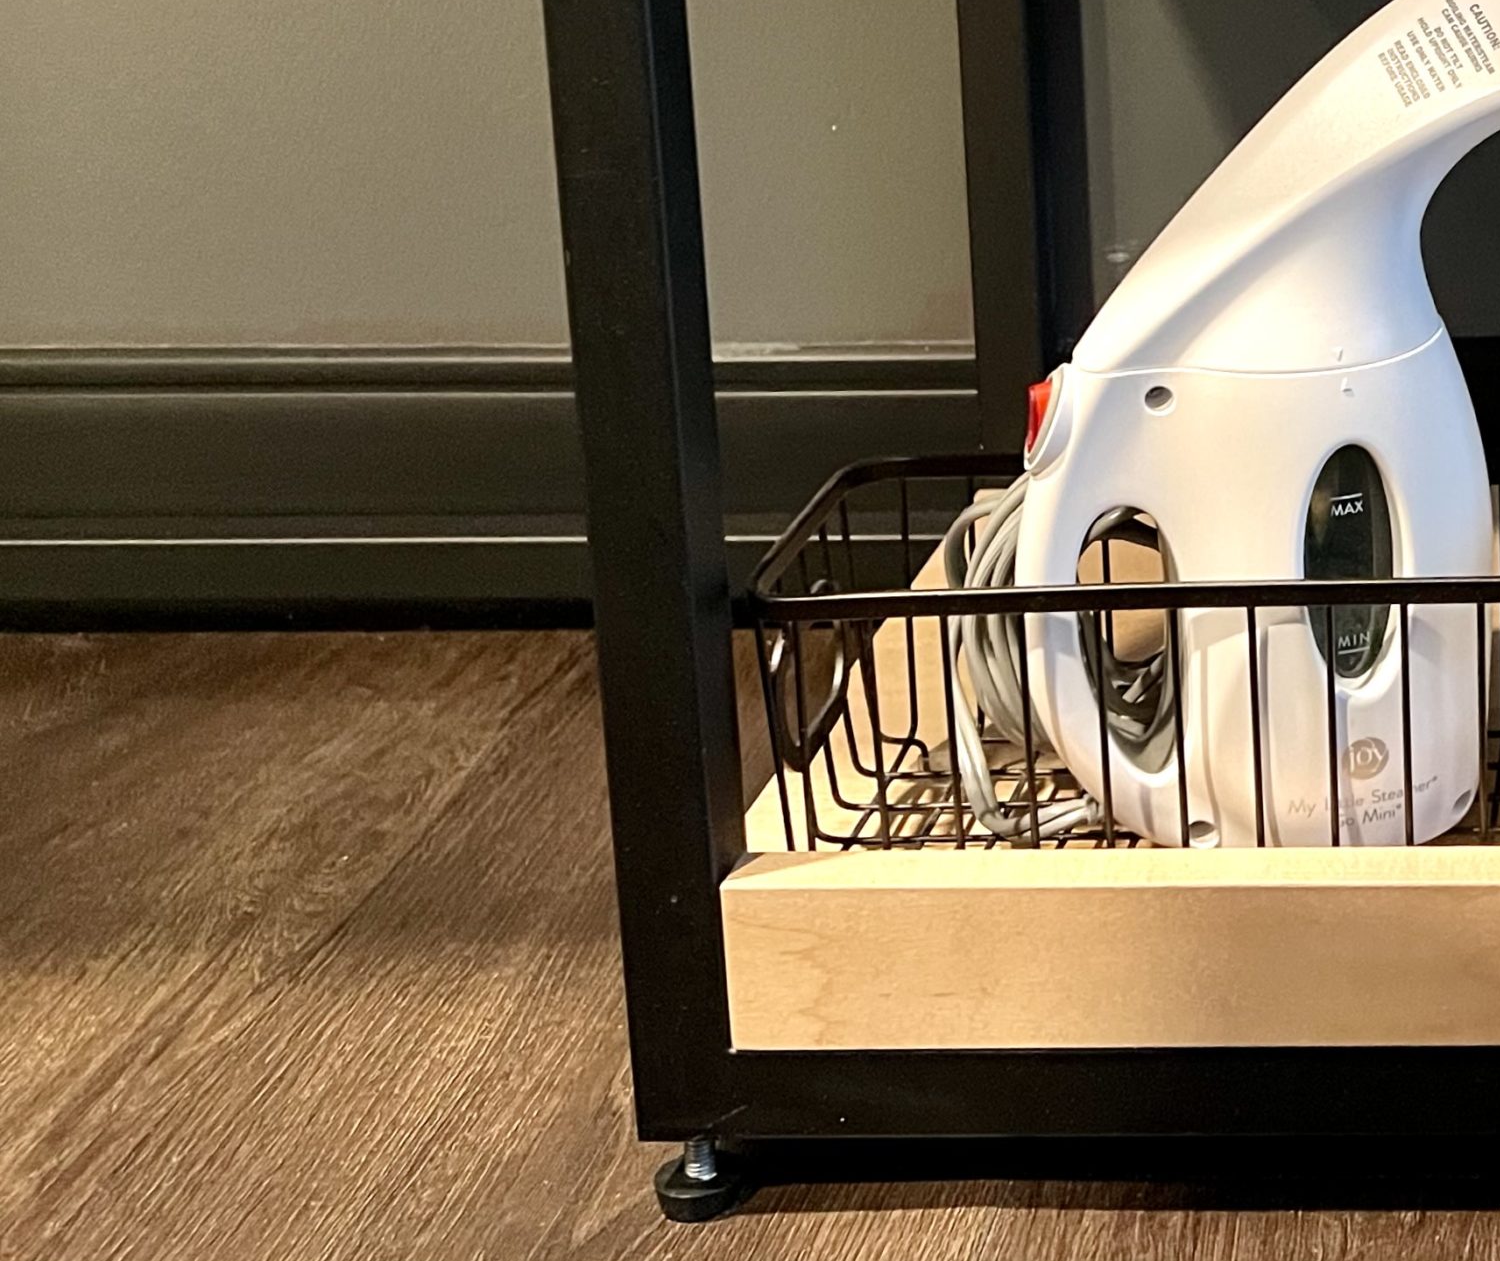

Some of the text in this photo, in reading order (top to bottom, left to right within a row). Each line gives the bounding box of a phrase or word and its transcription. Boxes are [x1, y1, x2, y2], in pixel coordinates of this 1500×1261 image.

[1470, 4, 1500, 50] CAUTION:
[1450, 53, 1463, 69] TILT
[1331, 501, 1364, 517] MAX
[1337, 631, 1371, 649] MIN
[1288, 798, 1317, 819] My
